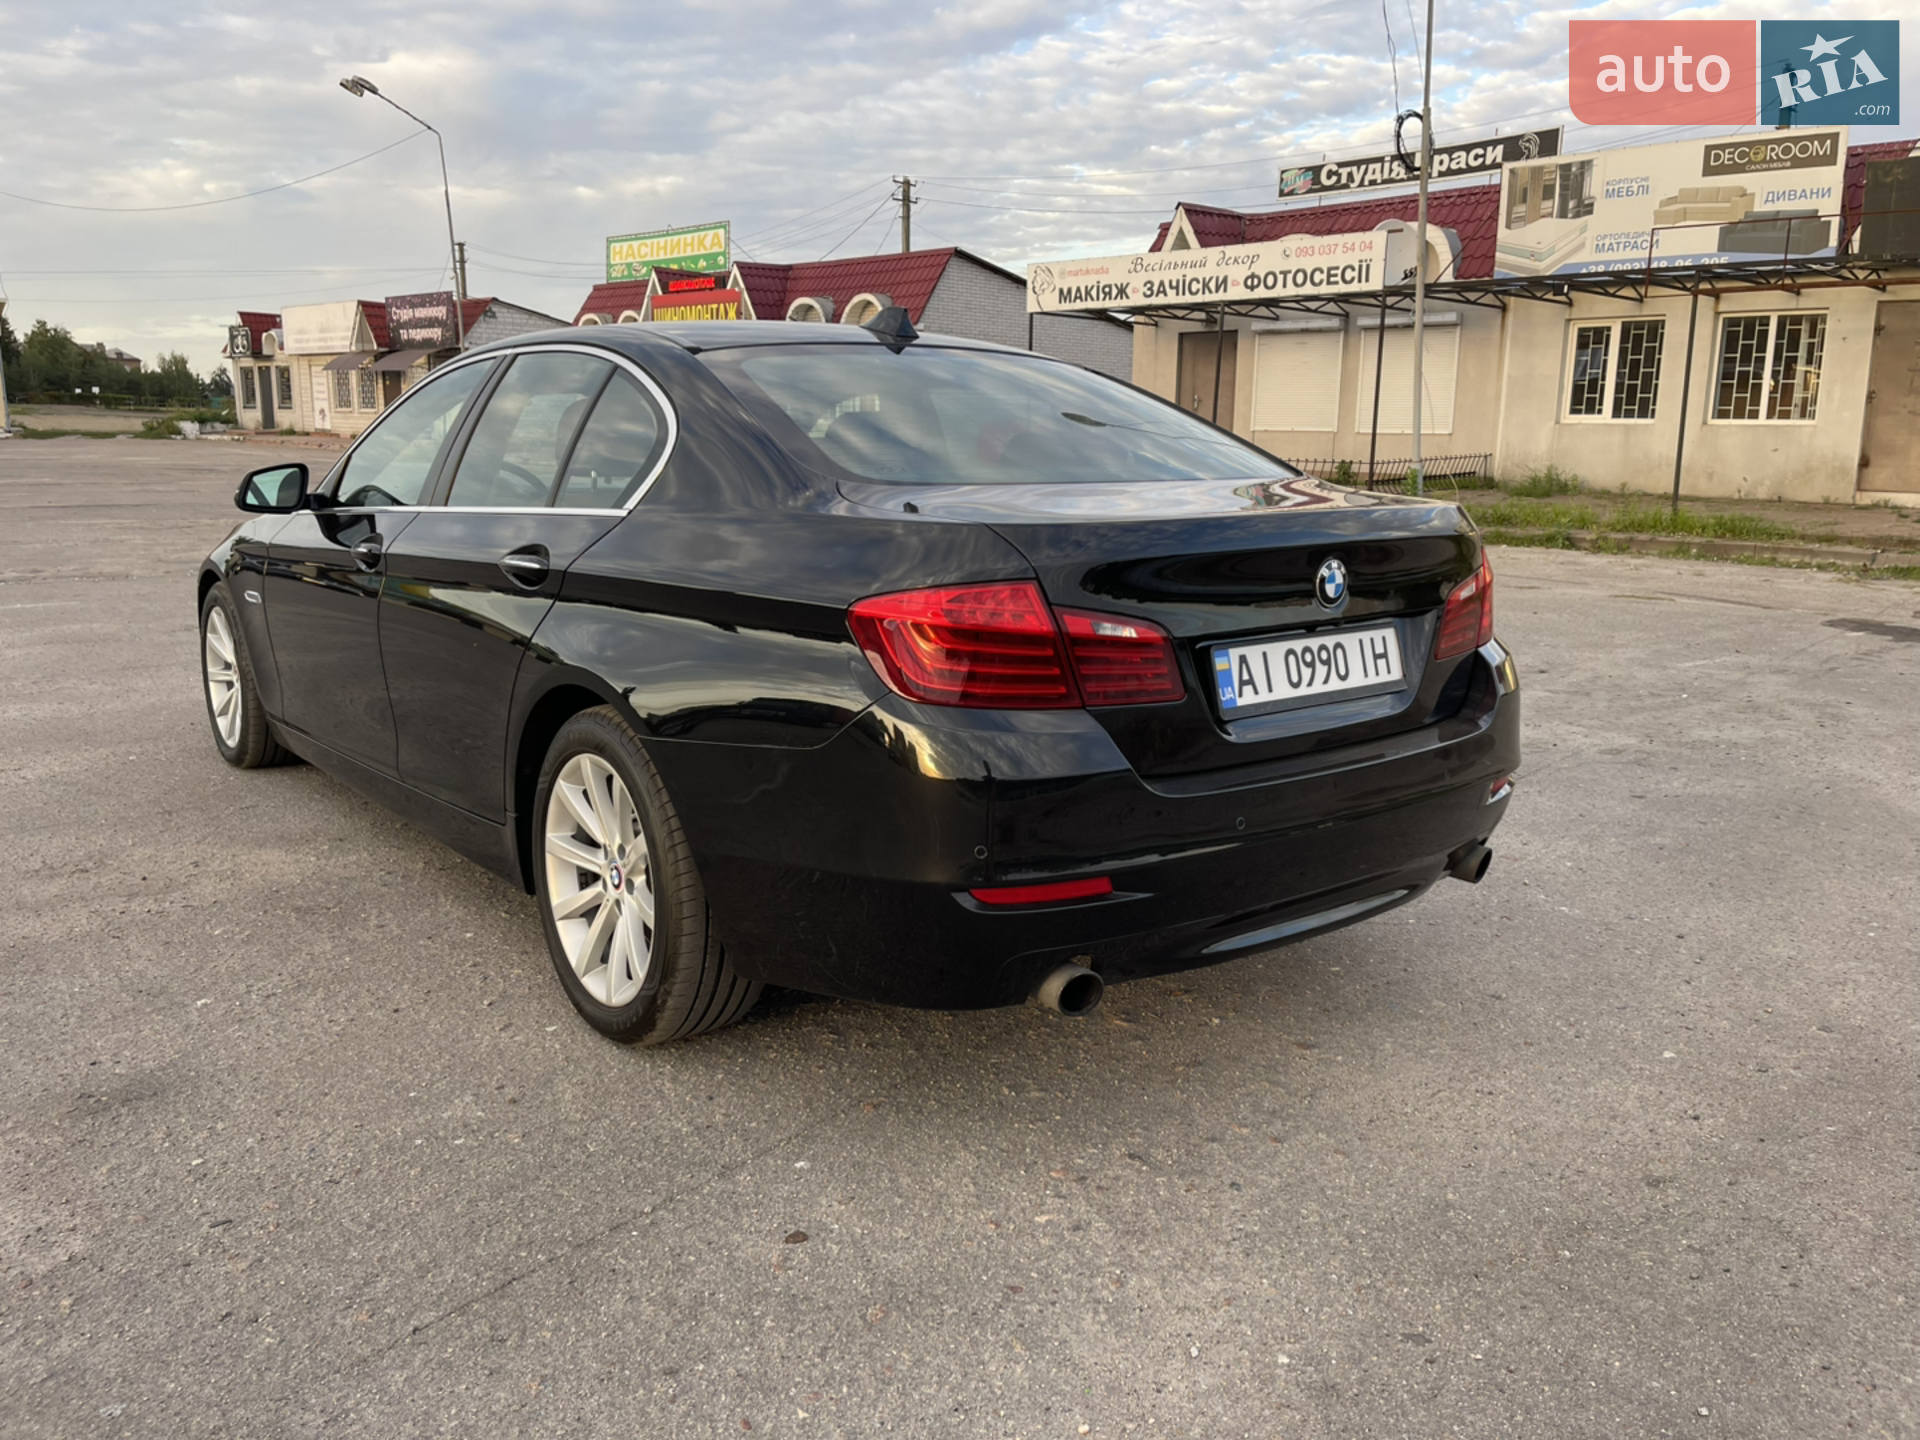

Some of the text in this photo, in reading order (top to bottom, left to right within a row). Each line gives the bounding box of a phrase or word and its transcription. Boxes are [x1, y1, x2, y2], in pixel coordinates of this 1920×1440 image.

[1606, 176, 1650, 187] КОРПУСНІ
[1605, 184, 1650, 199] МЕБЛІ
[1764, 187, 1832, 205] ДИВАНИ
[612, 231, 724, 262] НАСІНИНКА
[1295, 240, 1373, 258] 093 037 54 04
[1595, 239, 1660, 254] МАТРАСИ
[1128, 250, 1261, 274] Весільний декор
[1238, 635, 1392, 699] AI 0990 IH
[1219, 686, 1235, 701] UA
